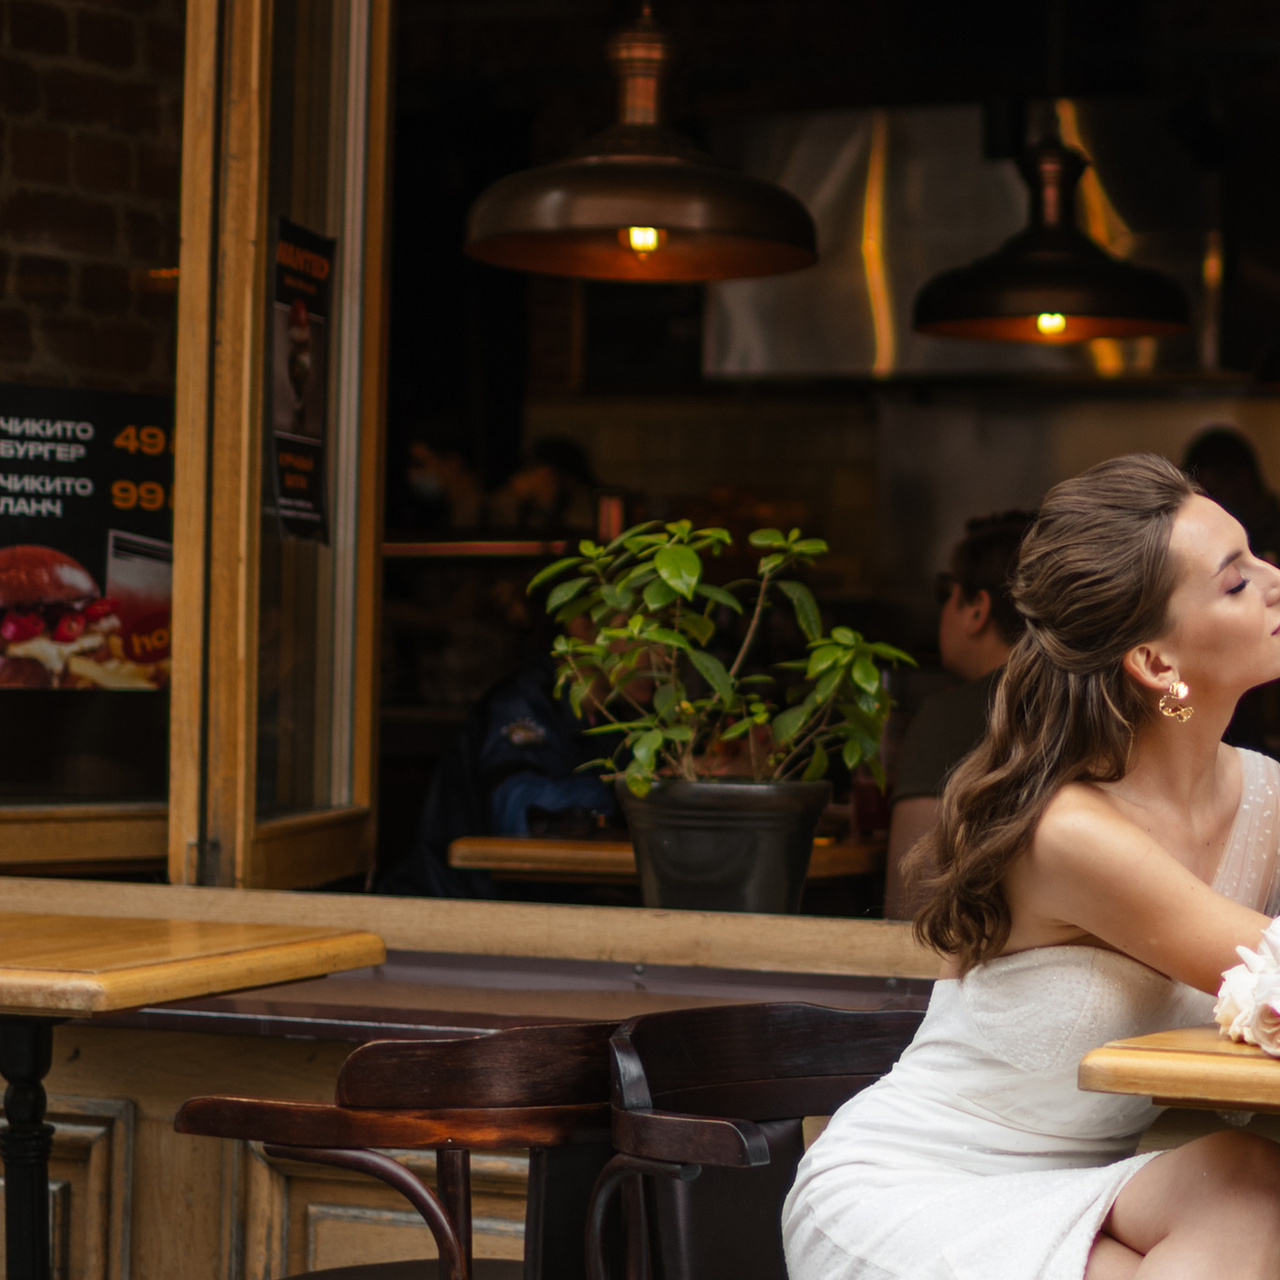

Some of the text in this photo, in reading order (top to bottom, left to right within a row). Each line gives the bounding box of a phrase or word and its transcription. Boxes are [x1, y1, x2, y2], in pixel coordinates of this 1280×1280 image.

[0, 416, 95, 441] ЧИКИТО
[112, 424, 173, 456] 49
[0, 439, 87, 463] БУРГЕР
[0, 496, 64, 518] ЛАНЧ
[110, 479, 172, 511] 99
